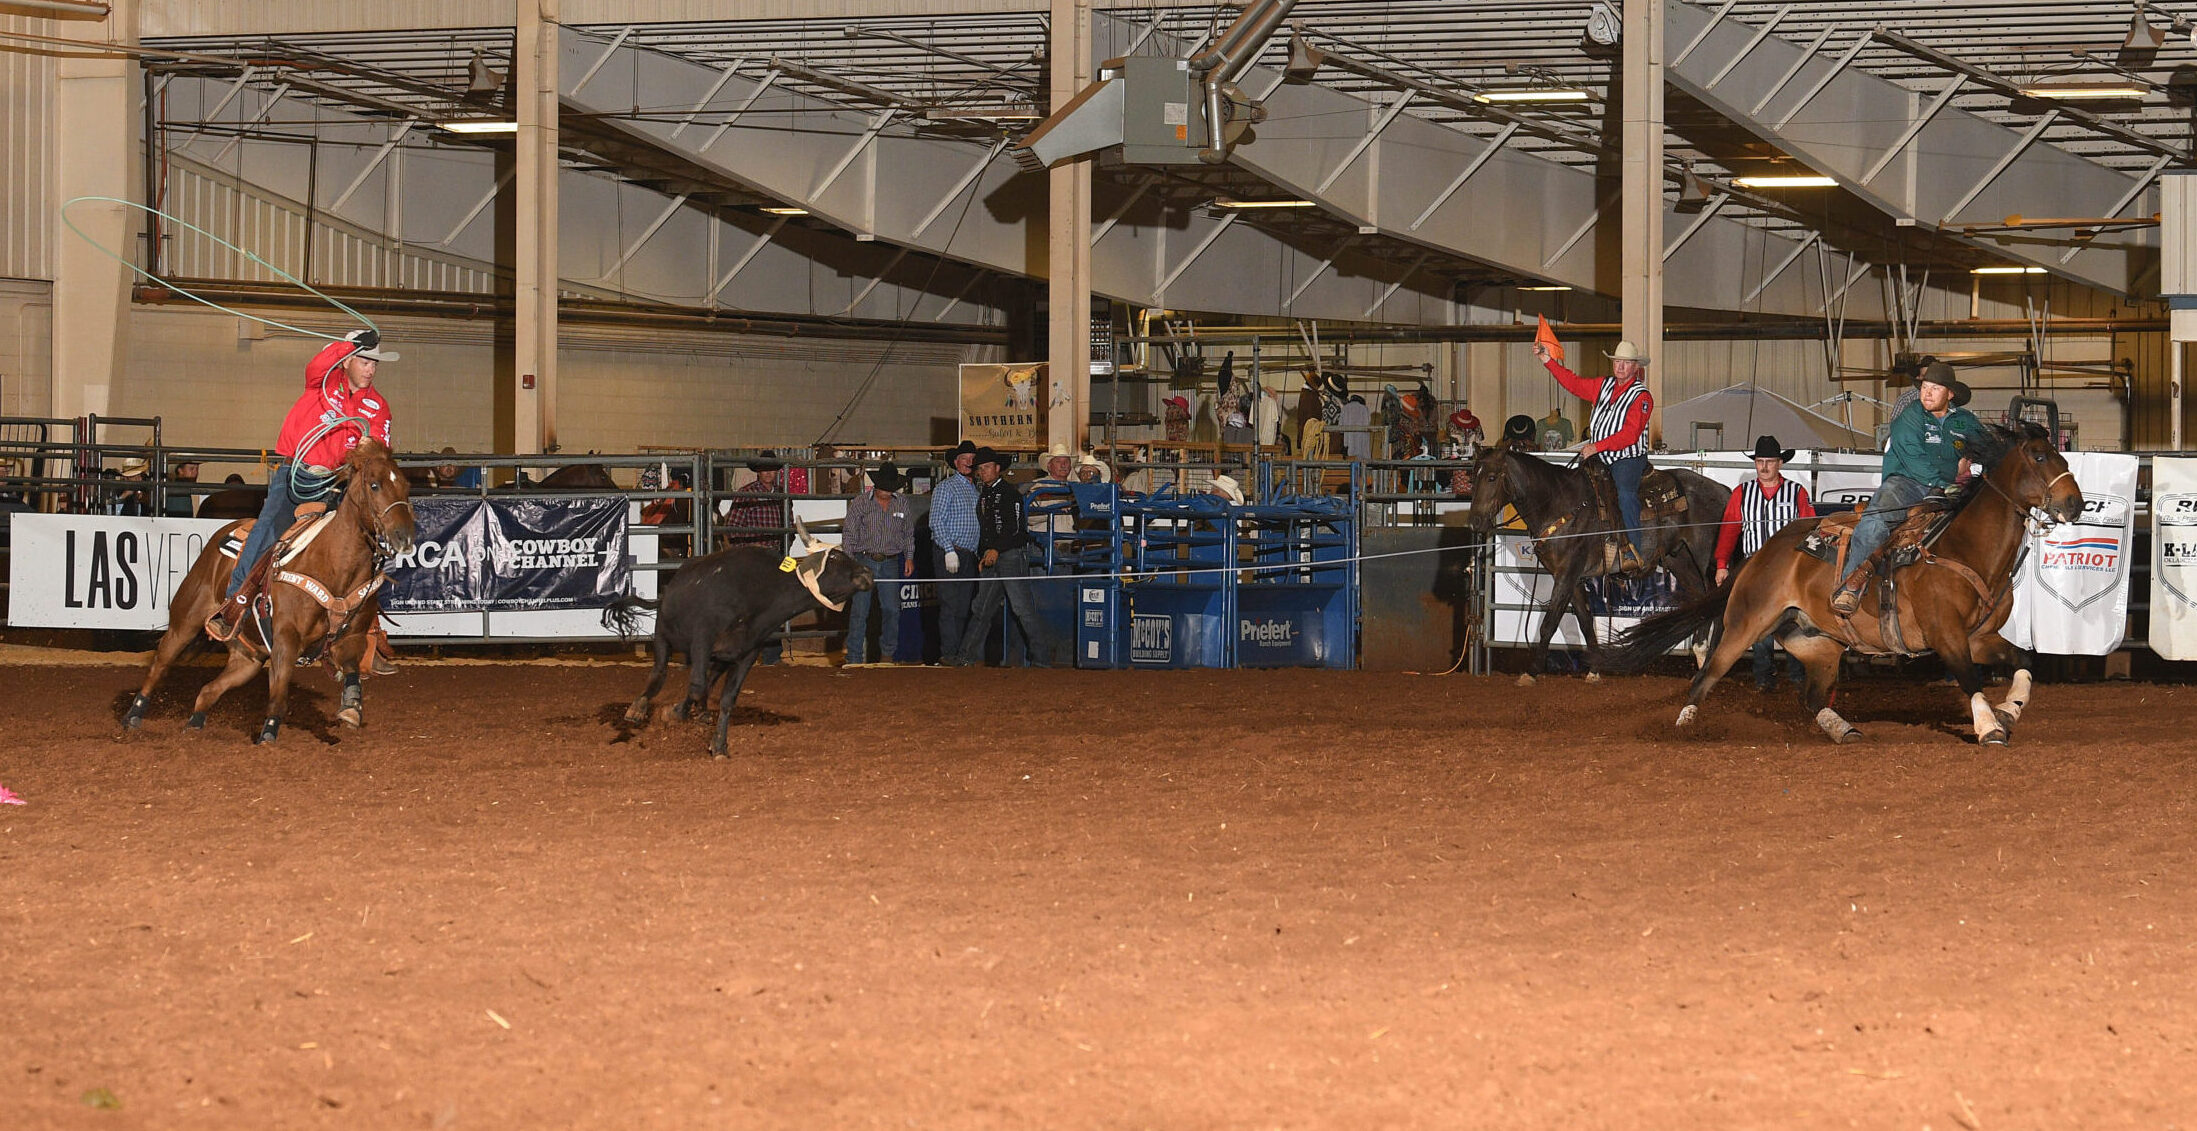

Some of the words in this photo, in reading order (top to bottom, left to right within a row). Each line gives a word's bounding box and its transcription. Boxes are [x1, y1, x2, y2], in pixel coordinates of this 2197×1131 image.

[969, 415, 1033, 426] SOUTHERN
[380, 541, 467, 569] RCA
[514, 537, 598, 555] COWBOY
[513, 552, 600, 570] CHANNEL
[2043, 552, 2118, 568] PATRIOT
[64, 530, 138, 611] LAS
[305, 580, 330, 603] WARD
[1633, 605, 1642, 613] UP
[1642, 605, 1654, 613] AND
[1240, 616, 1292, 641] Priefert
[1132, 650, 1152, 659] BUILDING
[1153, 650, 1169, 659] SUPPLY
